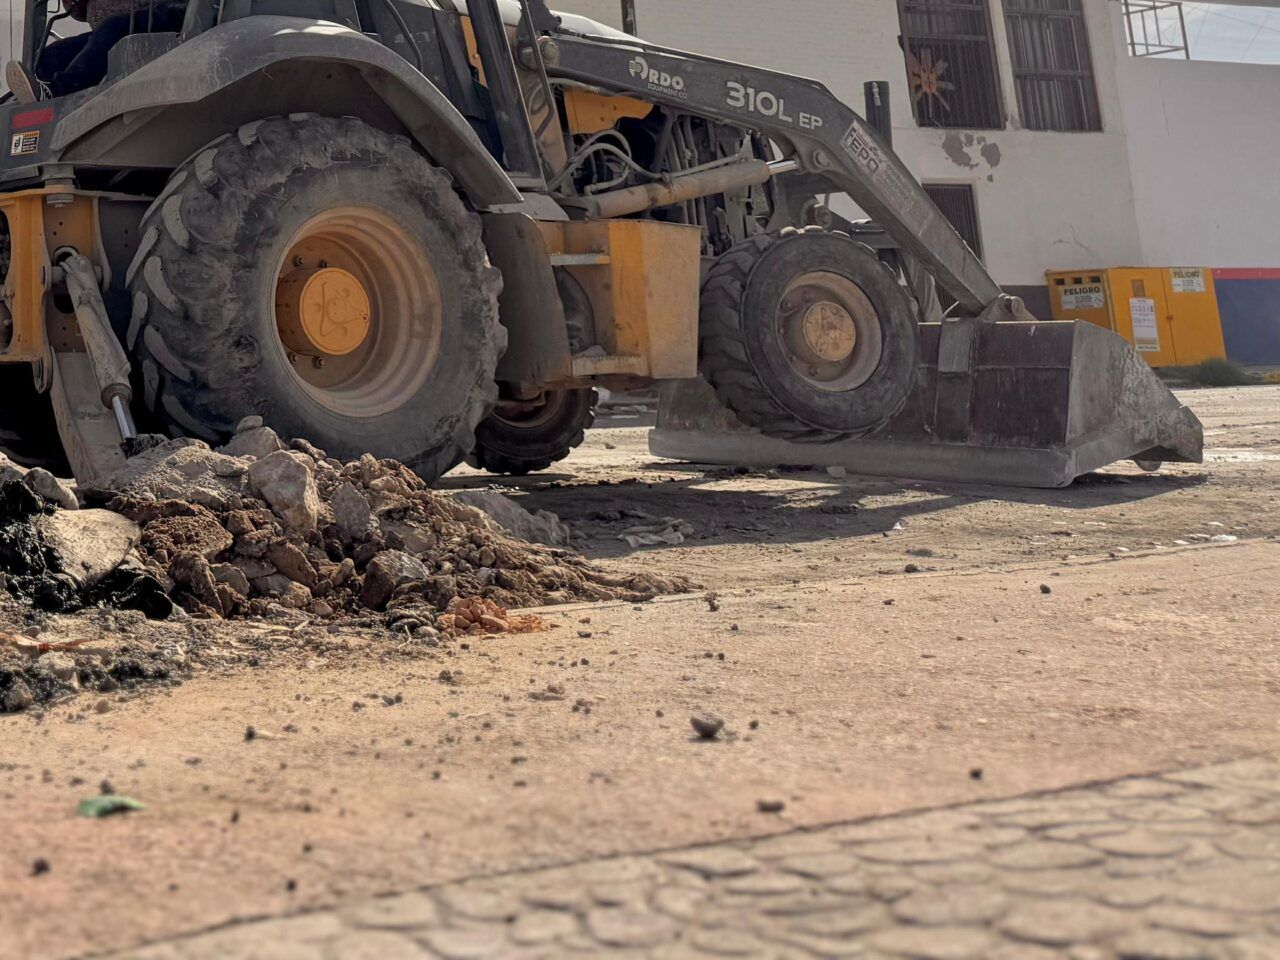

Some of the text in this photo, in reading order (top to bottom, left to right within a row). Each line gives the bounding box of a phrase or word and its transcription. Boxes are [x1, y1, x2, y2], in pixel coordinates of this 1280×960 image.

[648, 68, 684, 91] RDO
[726, 81, 823, 130] 310L EP
[844, 126, 879, 174] FEPO
[1063, 286, 1100, 295] PELIGRO
